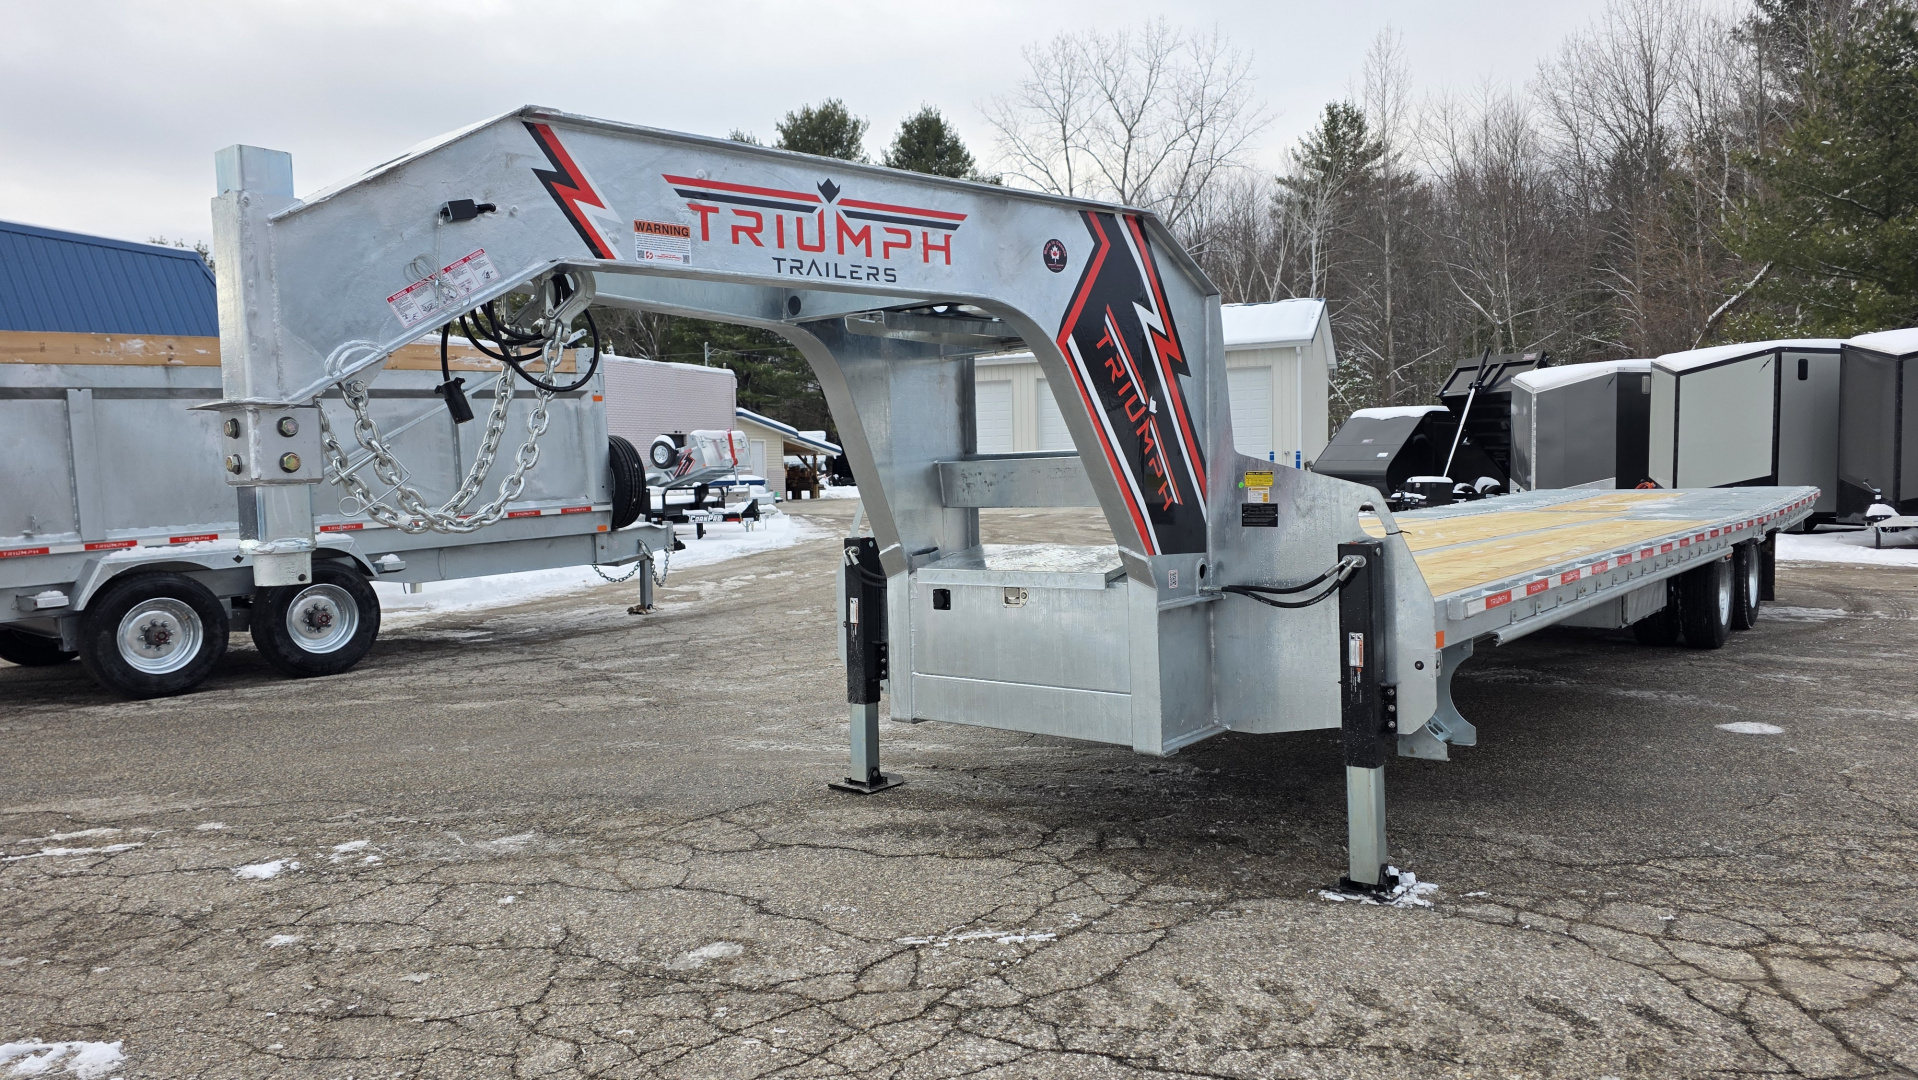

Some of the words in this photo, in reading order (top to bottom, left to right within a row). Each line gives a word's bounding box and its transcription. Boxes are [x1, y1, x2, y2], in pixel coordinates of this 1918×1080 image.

[634, 221, 689, 237] WARNING
[686, 203, 952, 265] TRIUMPH
[772, 256, 897, 283] TRAILERS
[1096, 326, 1174, 512] TRIUMPH
[3, 549, 39, 557] TRIUMPH
